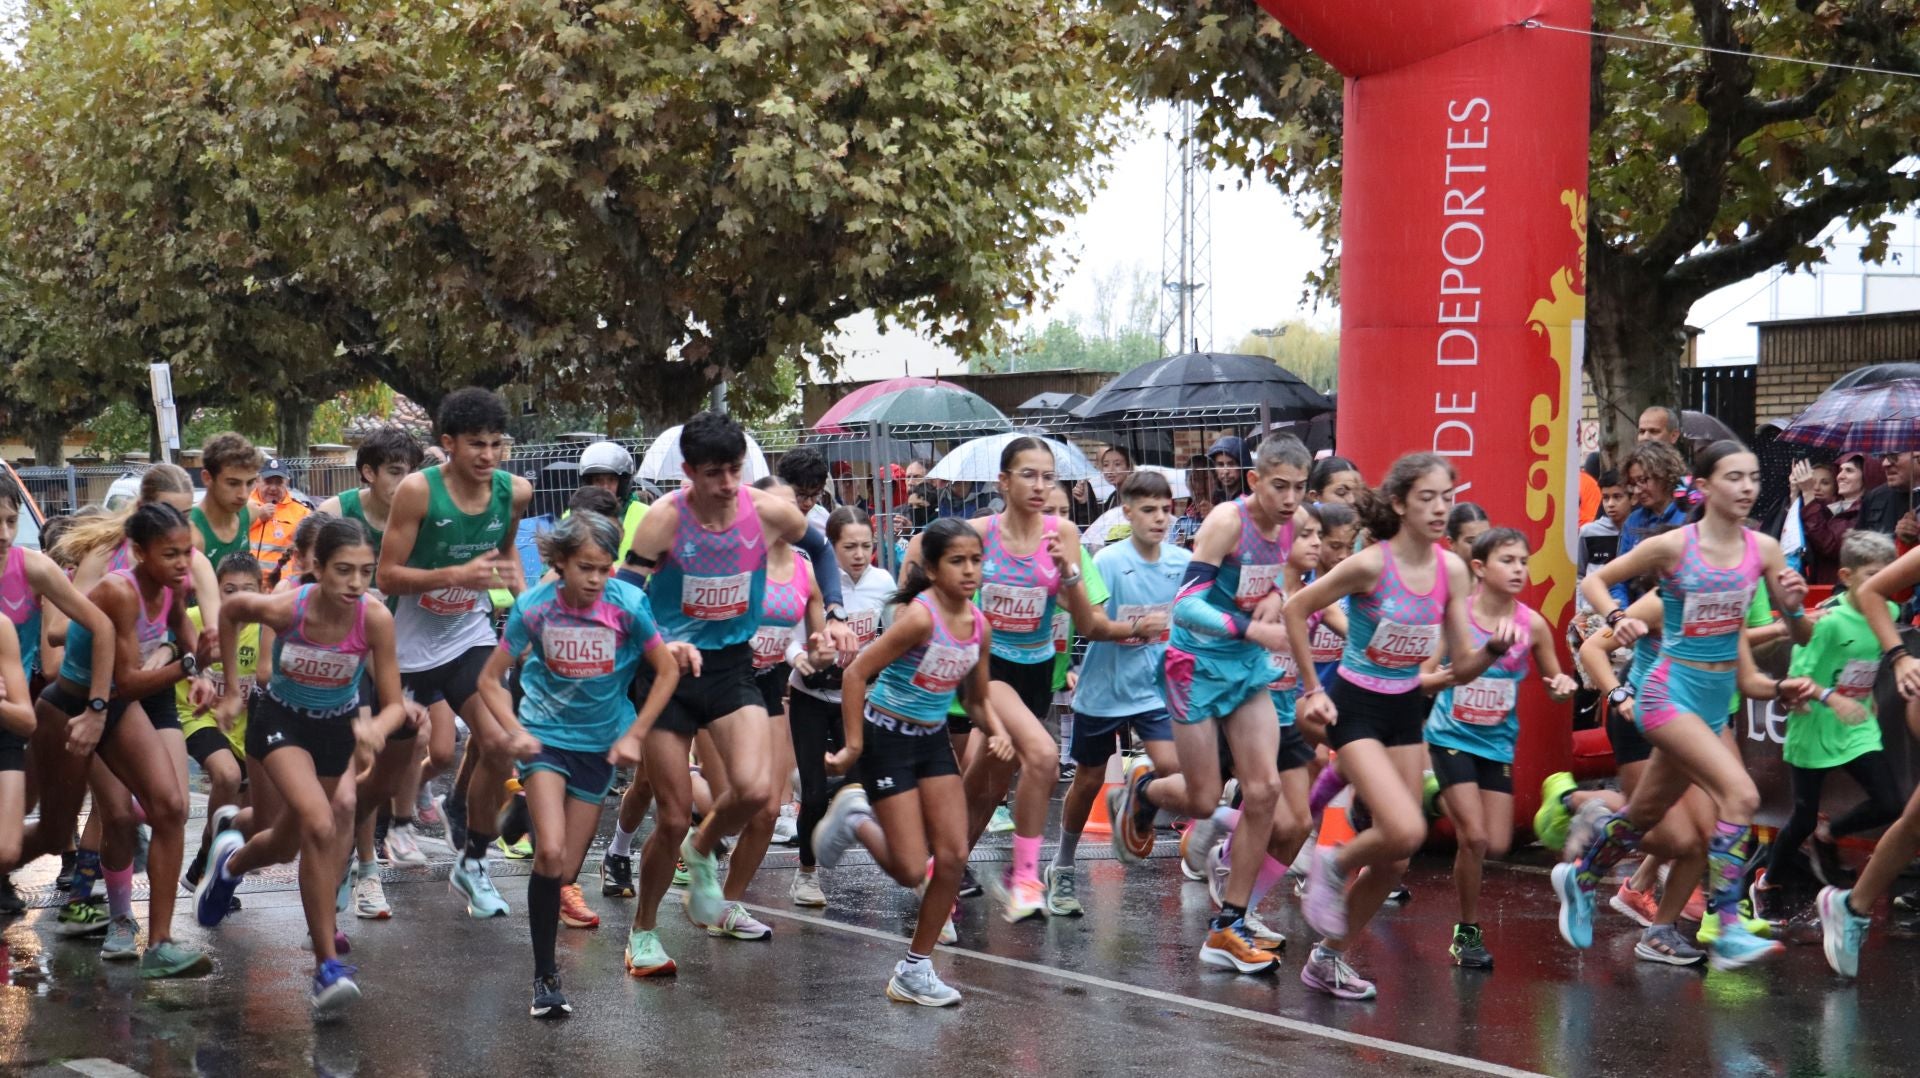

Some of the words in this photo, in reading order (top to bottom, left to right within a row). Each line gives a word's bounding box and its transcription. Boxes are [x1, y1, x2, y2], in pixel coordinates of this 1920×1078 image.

[1437, 97, 1490, 365] DEPORTES
[1433, 392, 1476, 456] DE
[694, 585, 739, 606] 2007
[992, 596, 1035, 616] 2044
[554, 640, 603, 661] 2045
[1382, 634, 1429, 655] 2053
[293, 658, 344, 678] 2037
